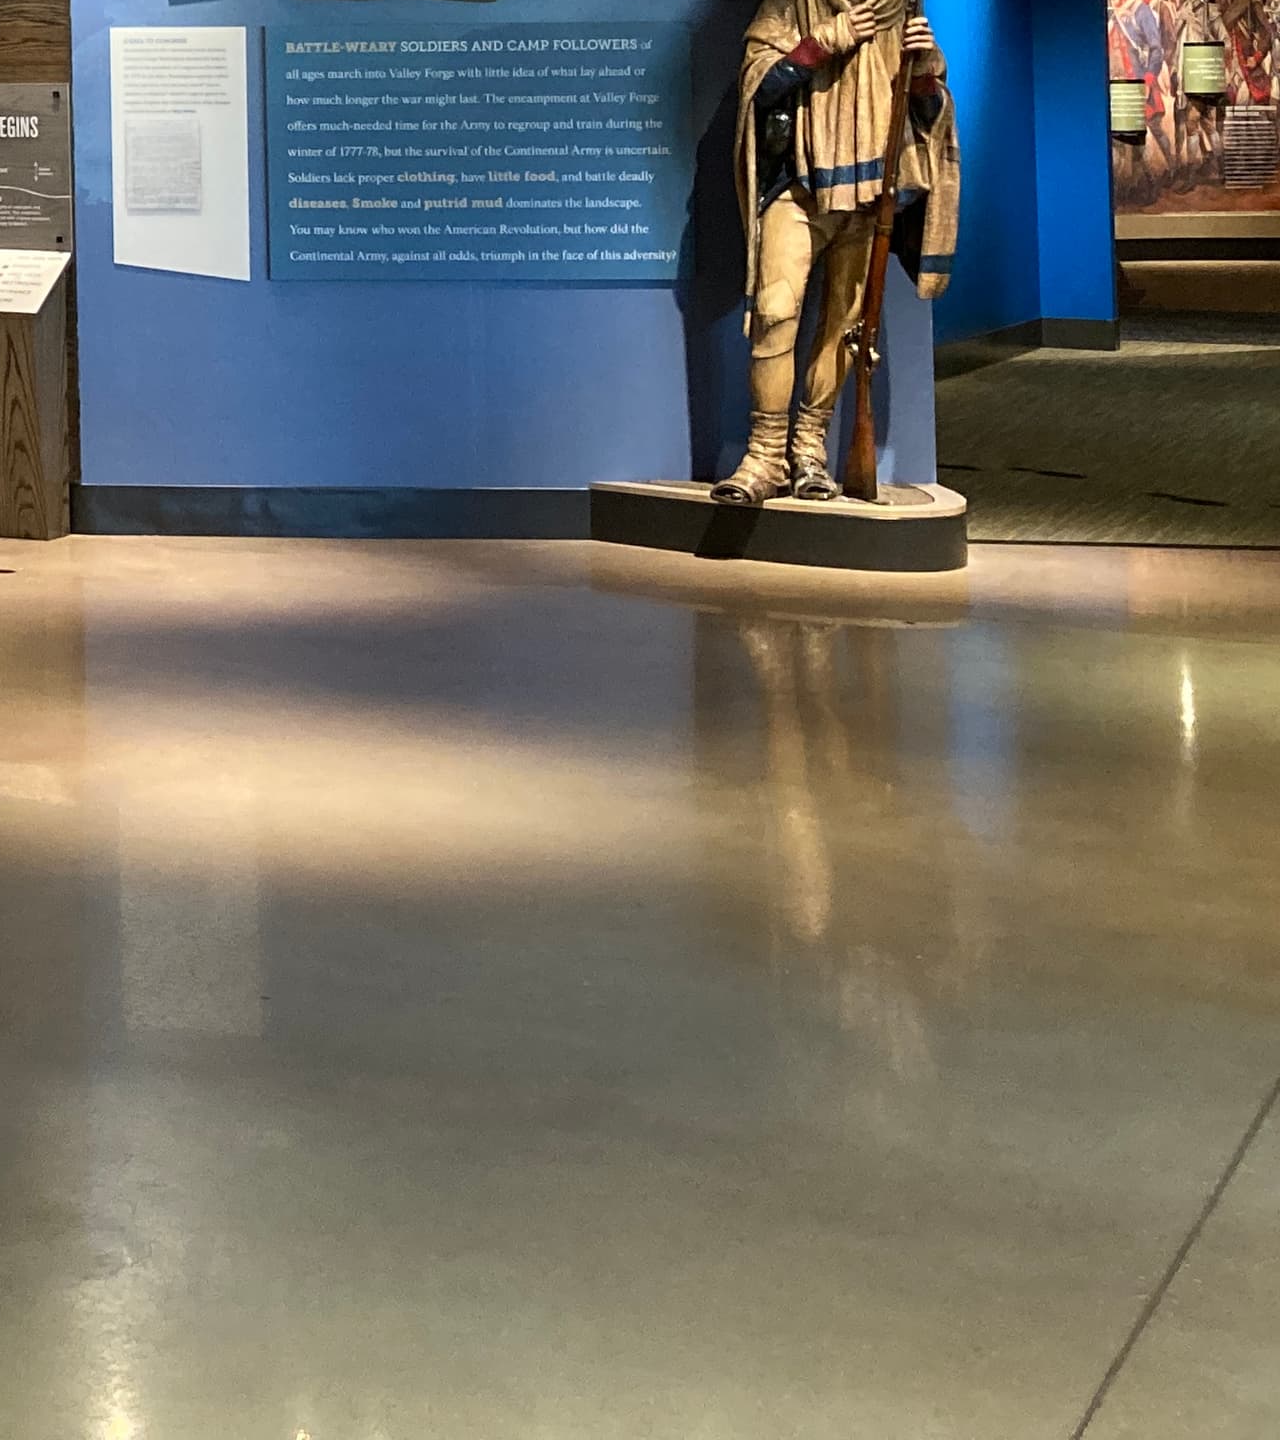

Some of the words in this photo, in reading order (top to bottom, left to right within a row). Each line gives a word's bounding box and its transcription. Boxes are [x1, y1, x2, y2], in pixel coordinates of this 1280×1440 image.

[285, 41, 396, 53] BATTLE-WEARY
[400, 40, 467, 52] SOLDIERS
[471, 40, 503, 51] AND
[506, 39, 549, 51] CAMP
[553, 38, 637, 51] FOLLOWERS
[288, 172, 331, 183] Soldiers
[333, 172, 355, 183] lack
[358, 174, 394, 185] proper
[461, 171, 485, 182] have
[487, 170, 520, 181] little
[561, 171, 582, 181] and
[584, 170, 616, 181] battle
[618, 170, 654, 183] deadly
[352, 197, 398, 208] Smoke
[400, 198, 421, 208] and
[424, 197, 467, 210] putrid
[471, 197, 503, 208] mud
[505, 197, 562, 208] dominates
[564, 197, 582, 208] the
[289, 224, 310, 234] You
[313, 226, 335, 237] may
[338, 224, 367, 234] know
[371, 224, 395, 234] who
[397, 226, 420, 234] won
[423, 224, 440, 234] the
[444, 224, 496, 234] American
[563, 223, 581, 234] but
[584, 223, 607, 234] how
[609, 223, 628, 234] did
[631, 223, 648, 233] the
[289, 250, 353, 261] Continental
[391, 250, 429, 263] against
[480, 250, 525, 263] triumph
[541, 250, 559, 260] the
[562, 249, 584, 260] face
[600, 249, 621, 260] this
